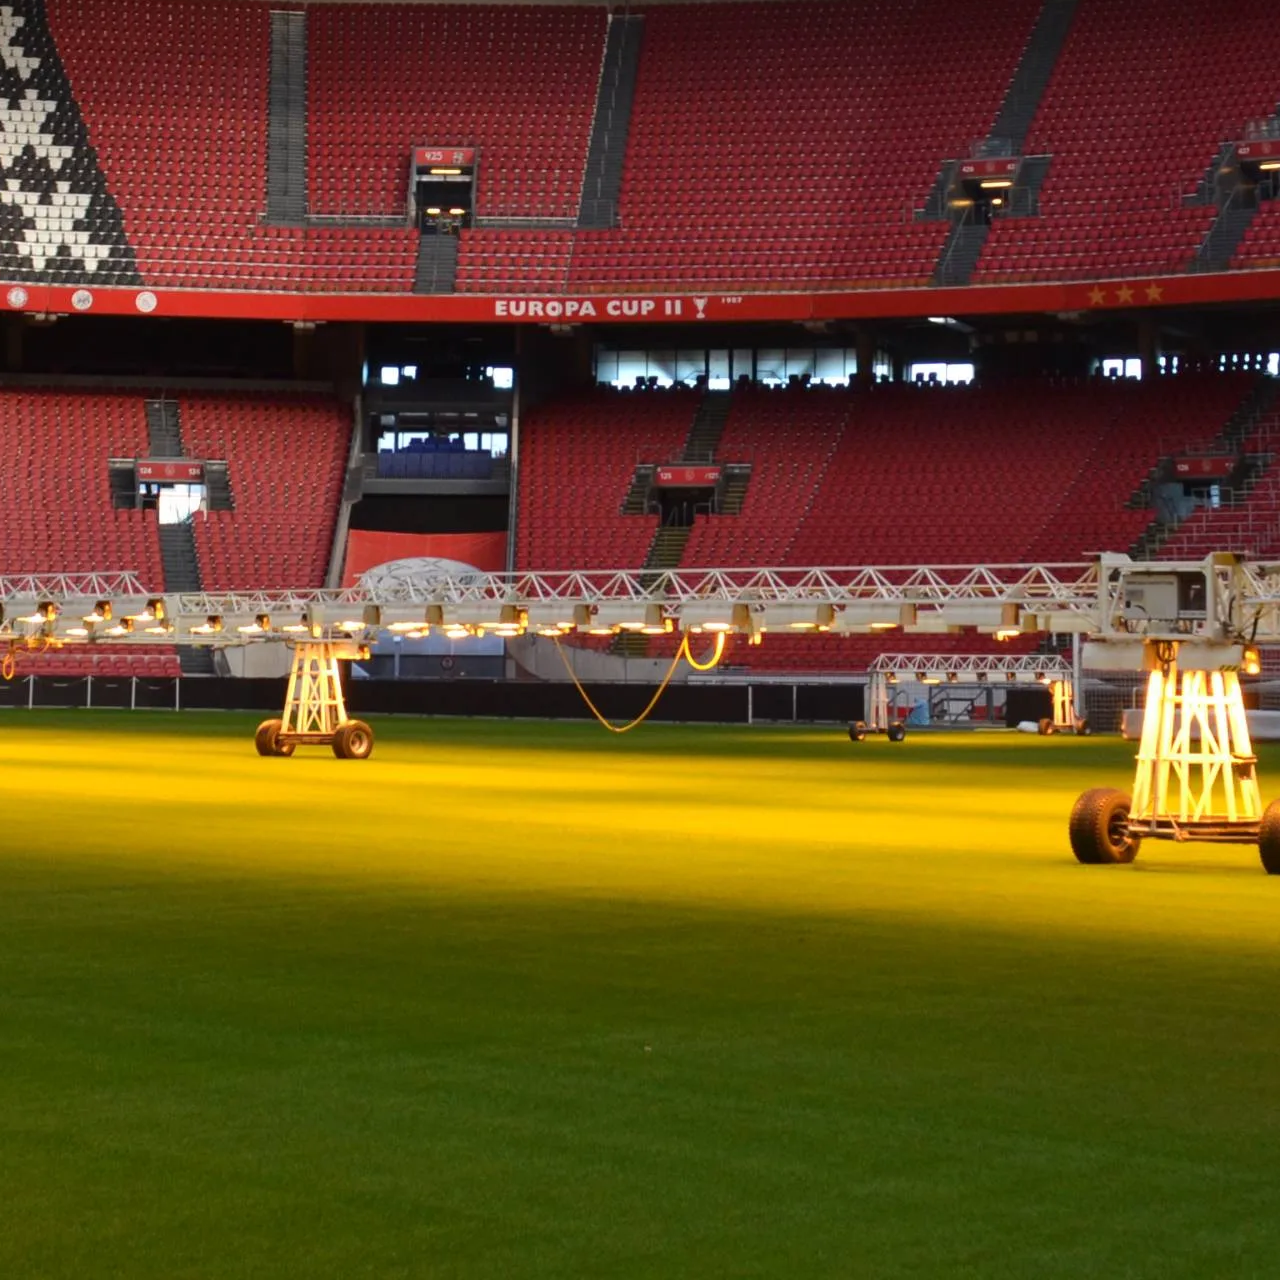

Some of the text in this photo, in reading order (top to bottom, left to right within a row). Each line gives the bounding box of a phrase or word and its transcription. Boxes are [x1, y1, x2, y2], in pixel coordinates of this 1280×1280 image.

[495, 300, 596, 316] EUROPA
[606, 300, 656, 316] CUP
[664, 299, 682, 315] II
